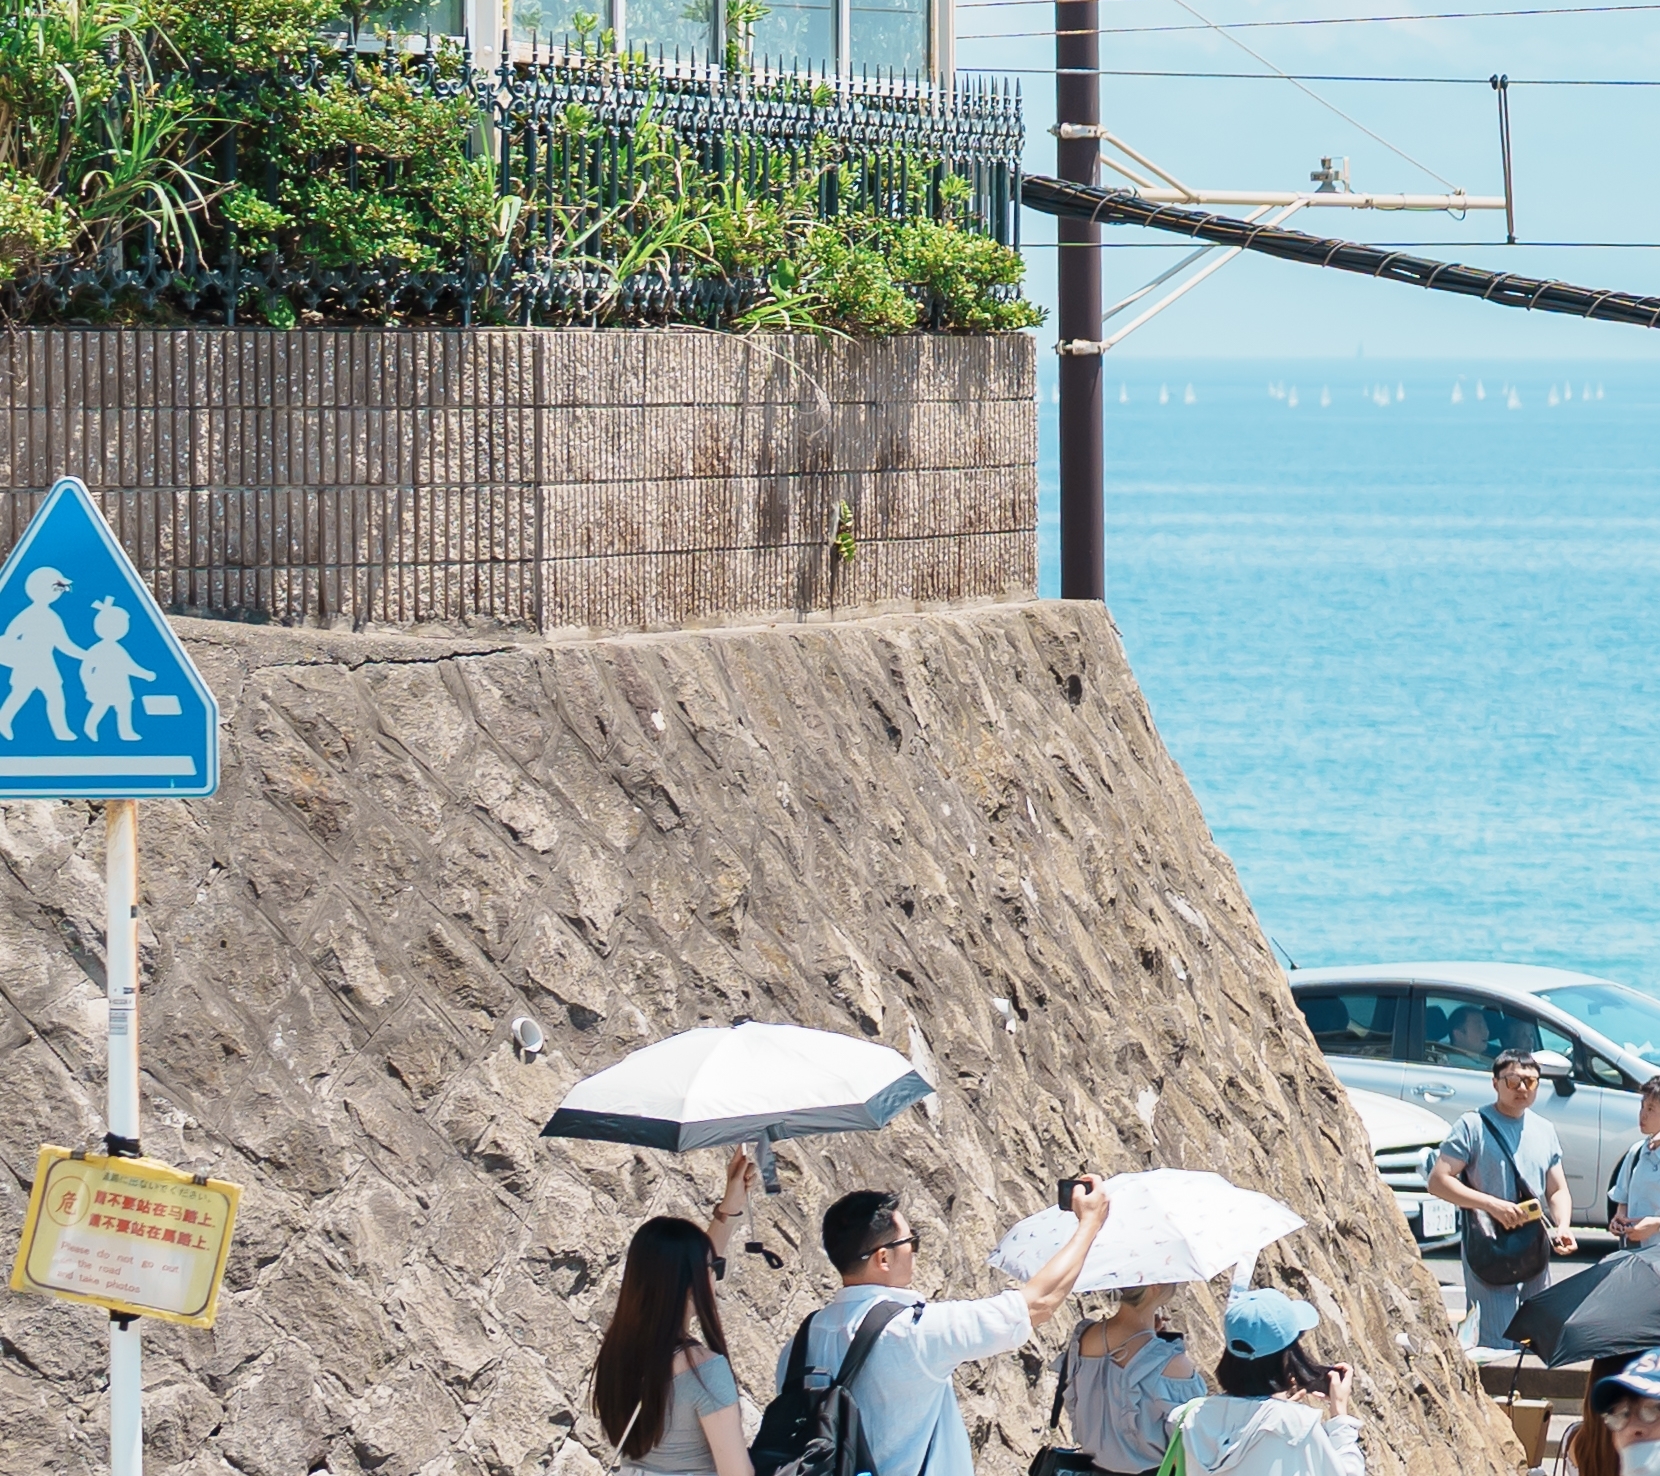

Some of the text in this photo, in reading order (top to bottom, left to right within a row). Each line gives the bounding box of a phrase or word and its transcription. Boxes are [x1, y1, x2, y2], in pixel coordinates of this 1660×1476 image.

[55, 1190, 78, 1215] 危
[61, 1240, 180, 1273] Please do not go out
[77, 1259, 93, 1270] the
[98, 1263, 122, 1276] road
[79, 1271, 100, 1287] take
[105, 1278, 141, 1294] photos
